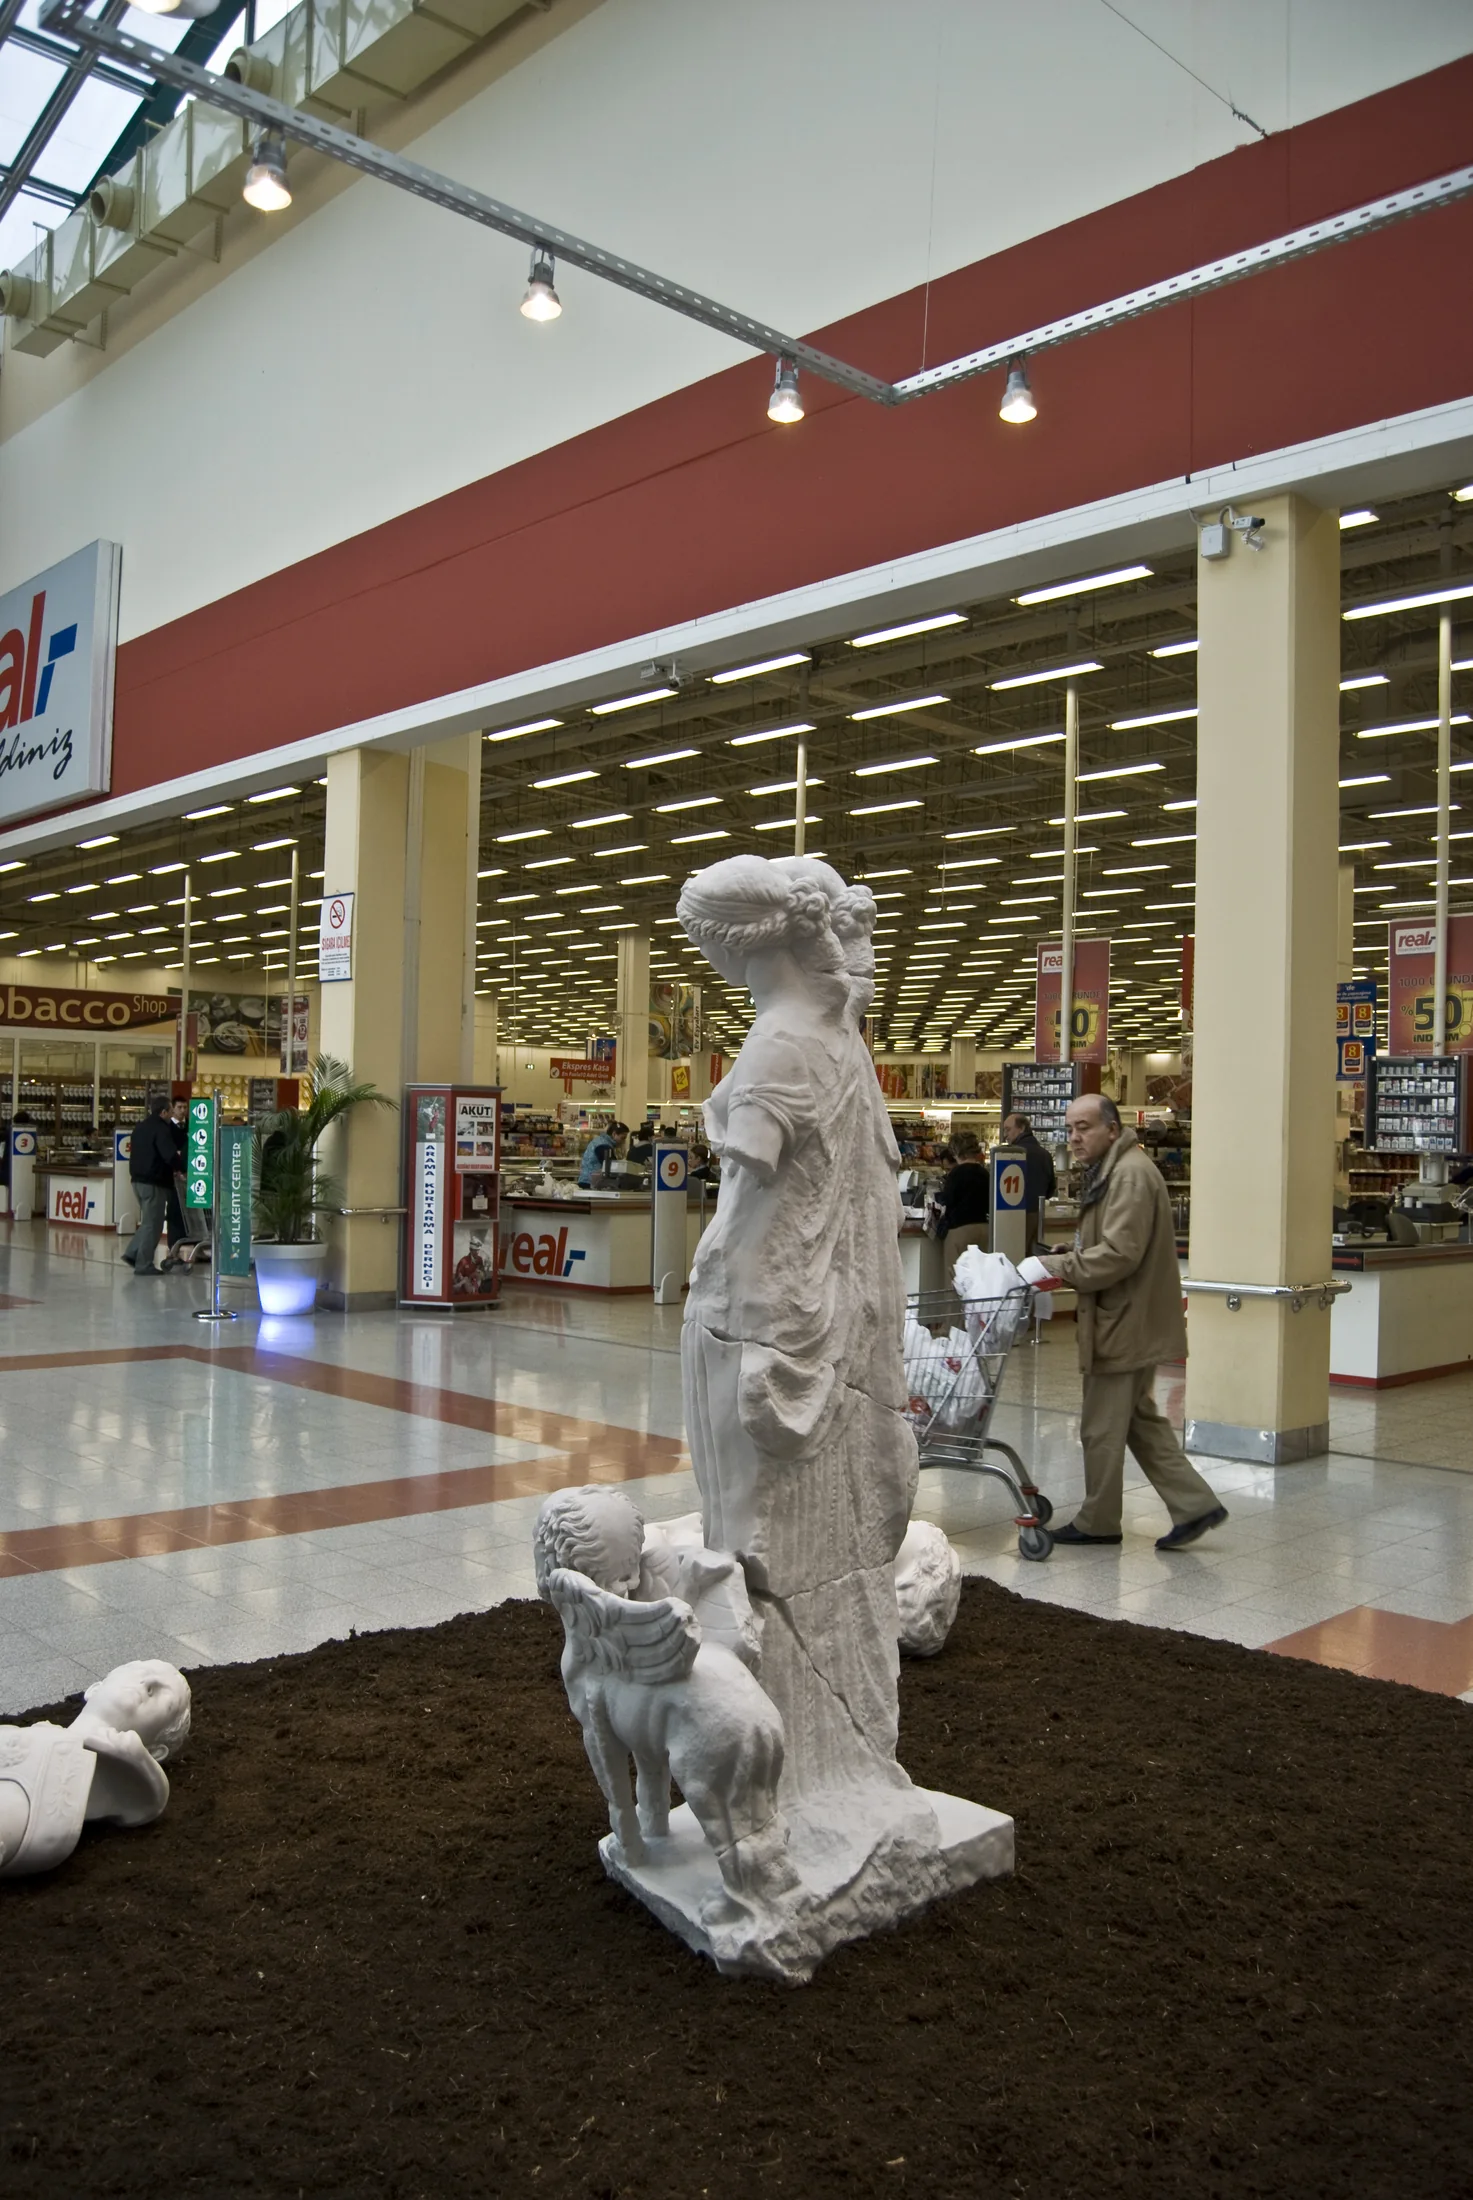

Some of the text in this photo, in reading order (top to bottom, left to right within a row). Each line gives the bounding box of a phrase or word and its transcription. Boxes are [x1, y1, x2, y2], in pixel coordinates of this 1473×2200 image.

[1044, 955, 1063, 967] rea
[1399, 977, 1425, 987] 1000
[0, 987, 167, 1025] bacco Shop
[1359, 1007, 1367, 1019] 8
[1348, 1045, 1357, 1057] 8
[562, 1061, 610, 1072] Ekspres Kasa
[460, 1105, 491, 1116] AKUT
[20, 1138, 29, 1148] 3
[231, 1142, 242, 1190] CENTER
[425, 1144, 436, 1177] ARAMA
[667, 1161, 679, 1177] 9
[1003, 1175, 1020, 1194] 11
[423, 1182, 435, 1235] KURTARMA
